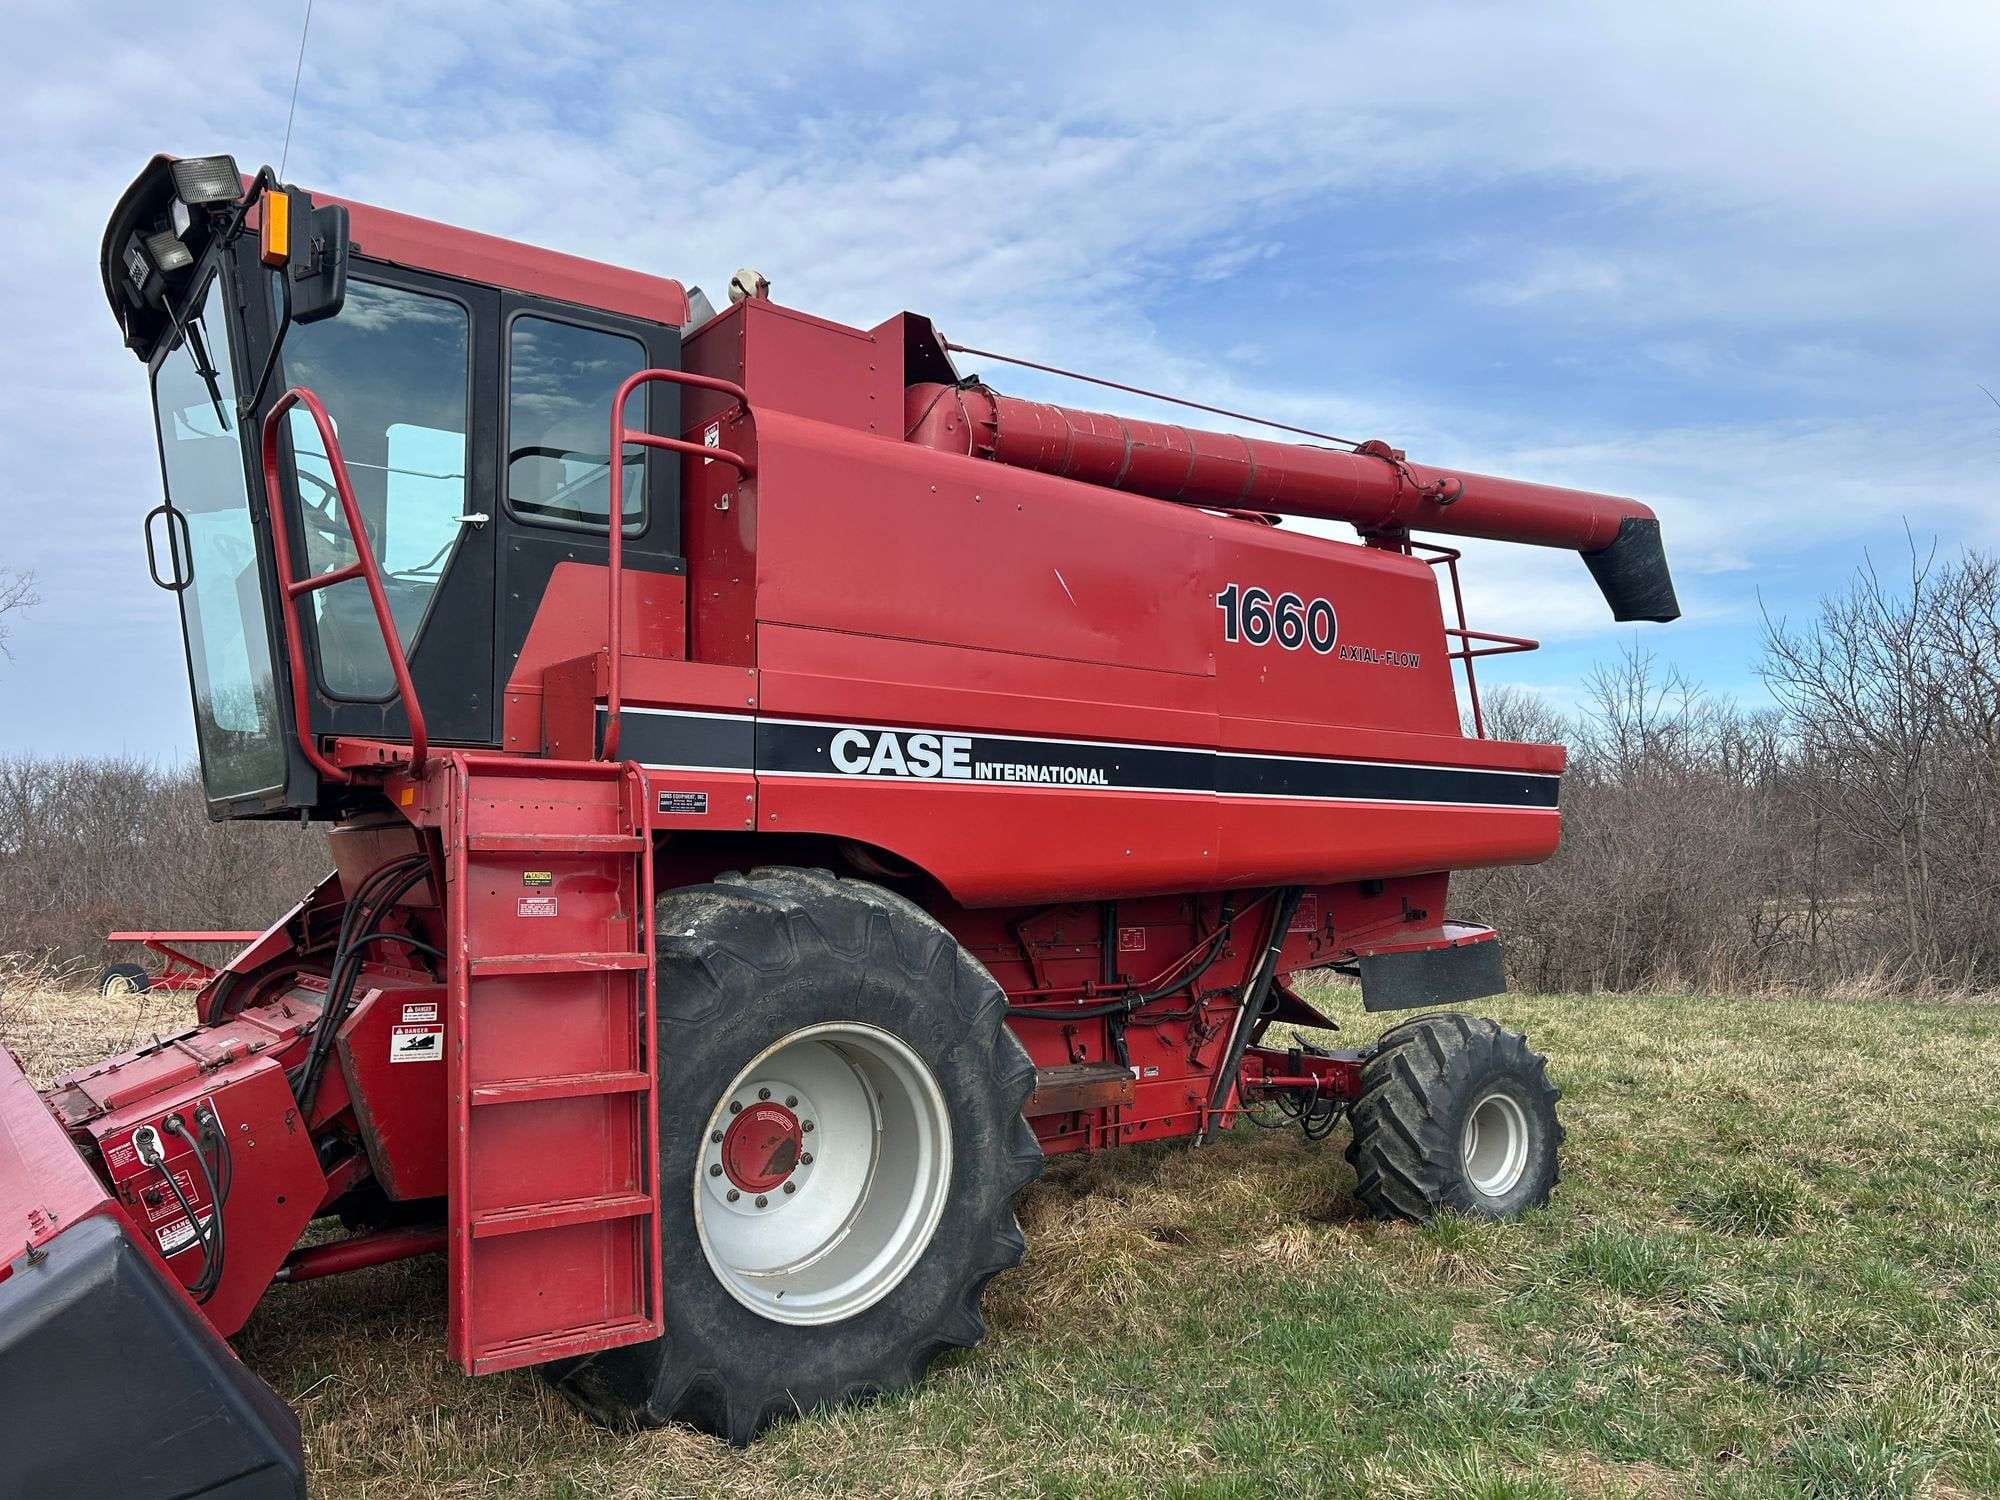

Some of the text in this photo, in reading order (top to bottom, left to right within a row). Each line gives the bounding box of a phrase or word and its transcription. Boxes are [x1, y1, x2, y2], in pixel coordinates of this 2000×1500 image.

[1216, 583, 1337, 655] 1660
[1339, 646, 1421, 668] AXIAL-FLOW
[830, 729, 1109, 785] CASE INTERNATIONAL
